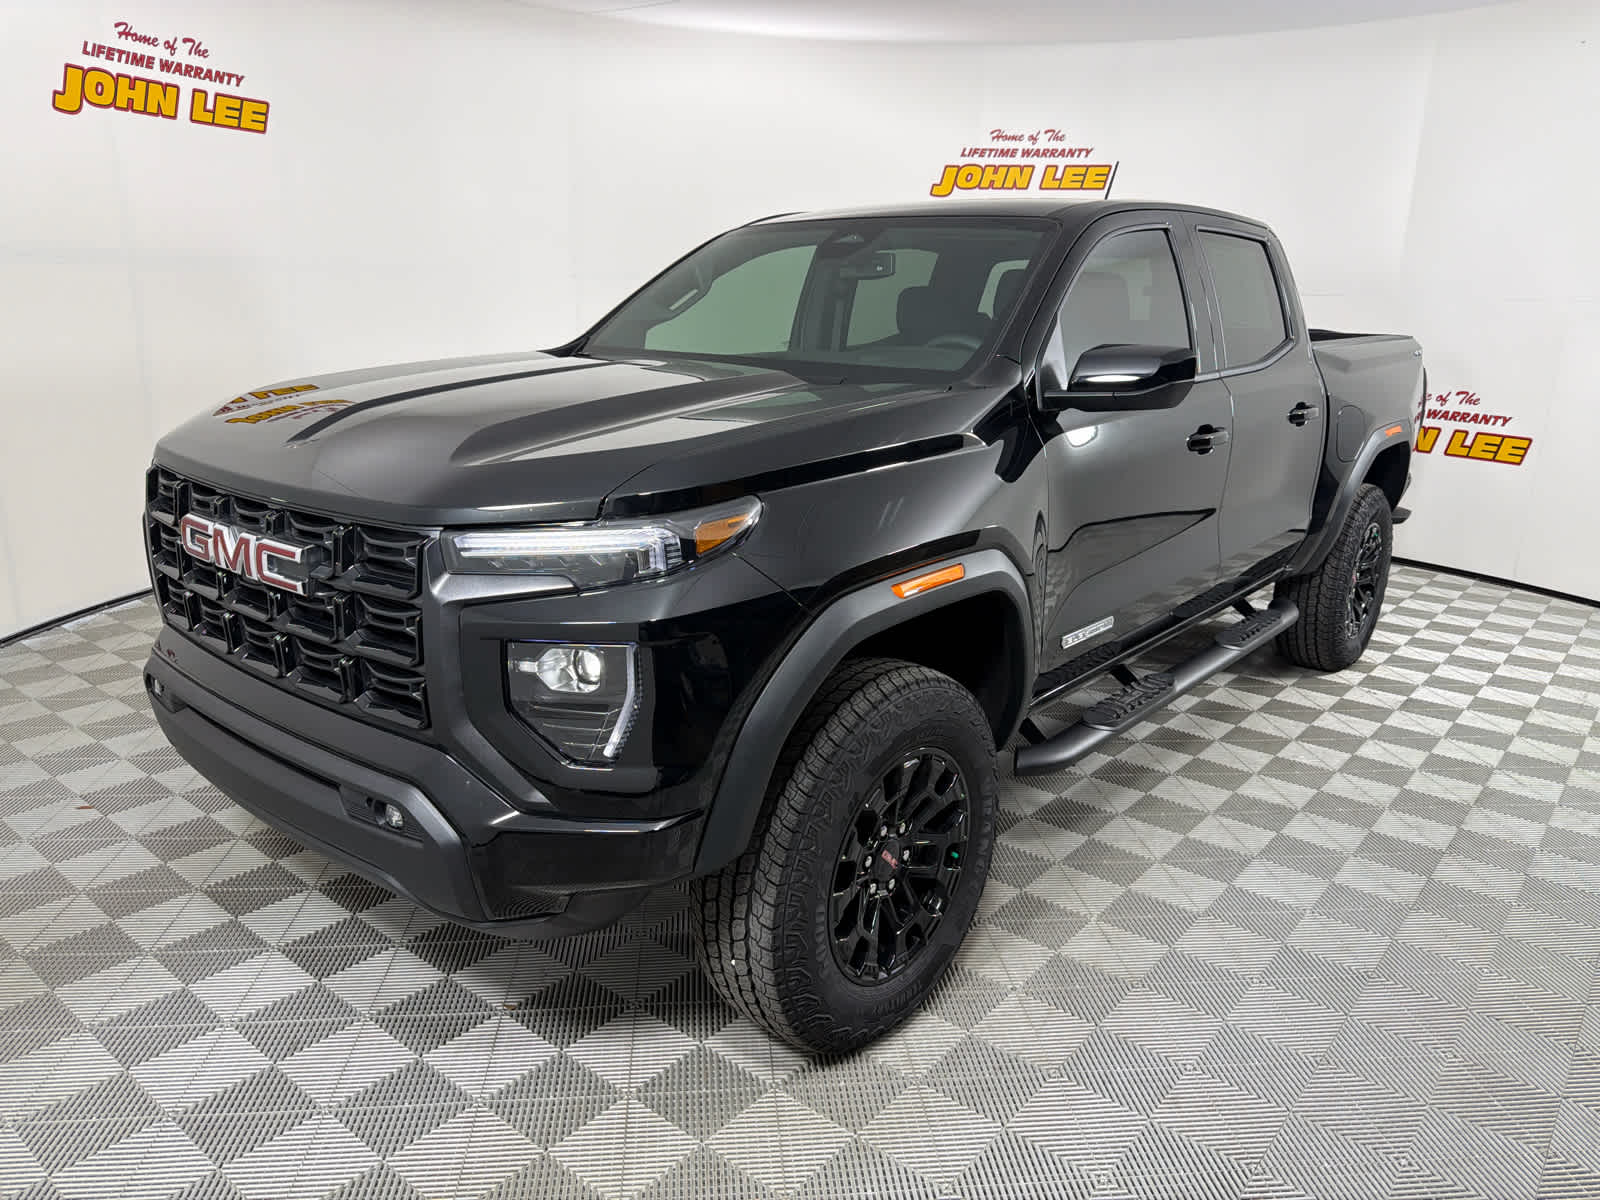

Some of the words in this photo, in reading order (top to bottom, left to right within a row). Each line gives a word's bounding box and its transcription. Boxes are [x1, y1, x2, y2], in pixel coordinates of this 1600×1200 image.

[114, 21, 159, 47] Home
[163, 37, 178, 56] of
[182, 37, 210, 58] The
[82, 41, 155, 70] LIFETIME
[159, 58, 245, 87] WARRANTY
[52, 62, 180, 120] JOHN
[189, 88, 270, 135] LEE
[960, 147, 1018, 158] LIFETIME
[1021, 147, 1094, 159] WARRANTY
[989, 128, 1025, 143] Home
[1027, 129, 1040, 145] of
[1044, 128, 1066, 143] The
[929, 163, 1035, 197] JOHN
[1039, 164, 1112, 190] LEE
[1435, 391, 1451, 407] of
[1455, 390, 1481, 406] The
[1426, 408, 1513, 427] WARRANTY
[1444, 429, 1533, 466] LEE
[181, 513, 307, 597] GMC
